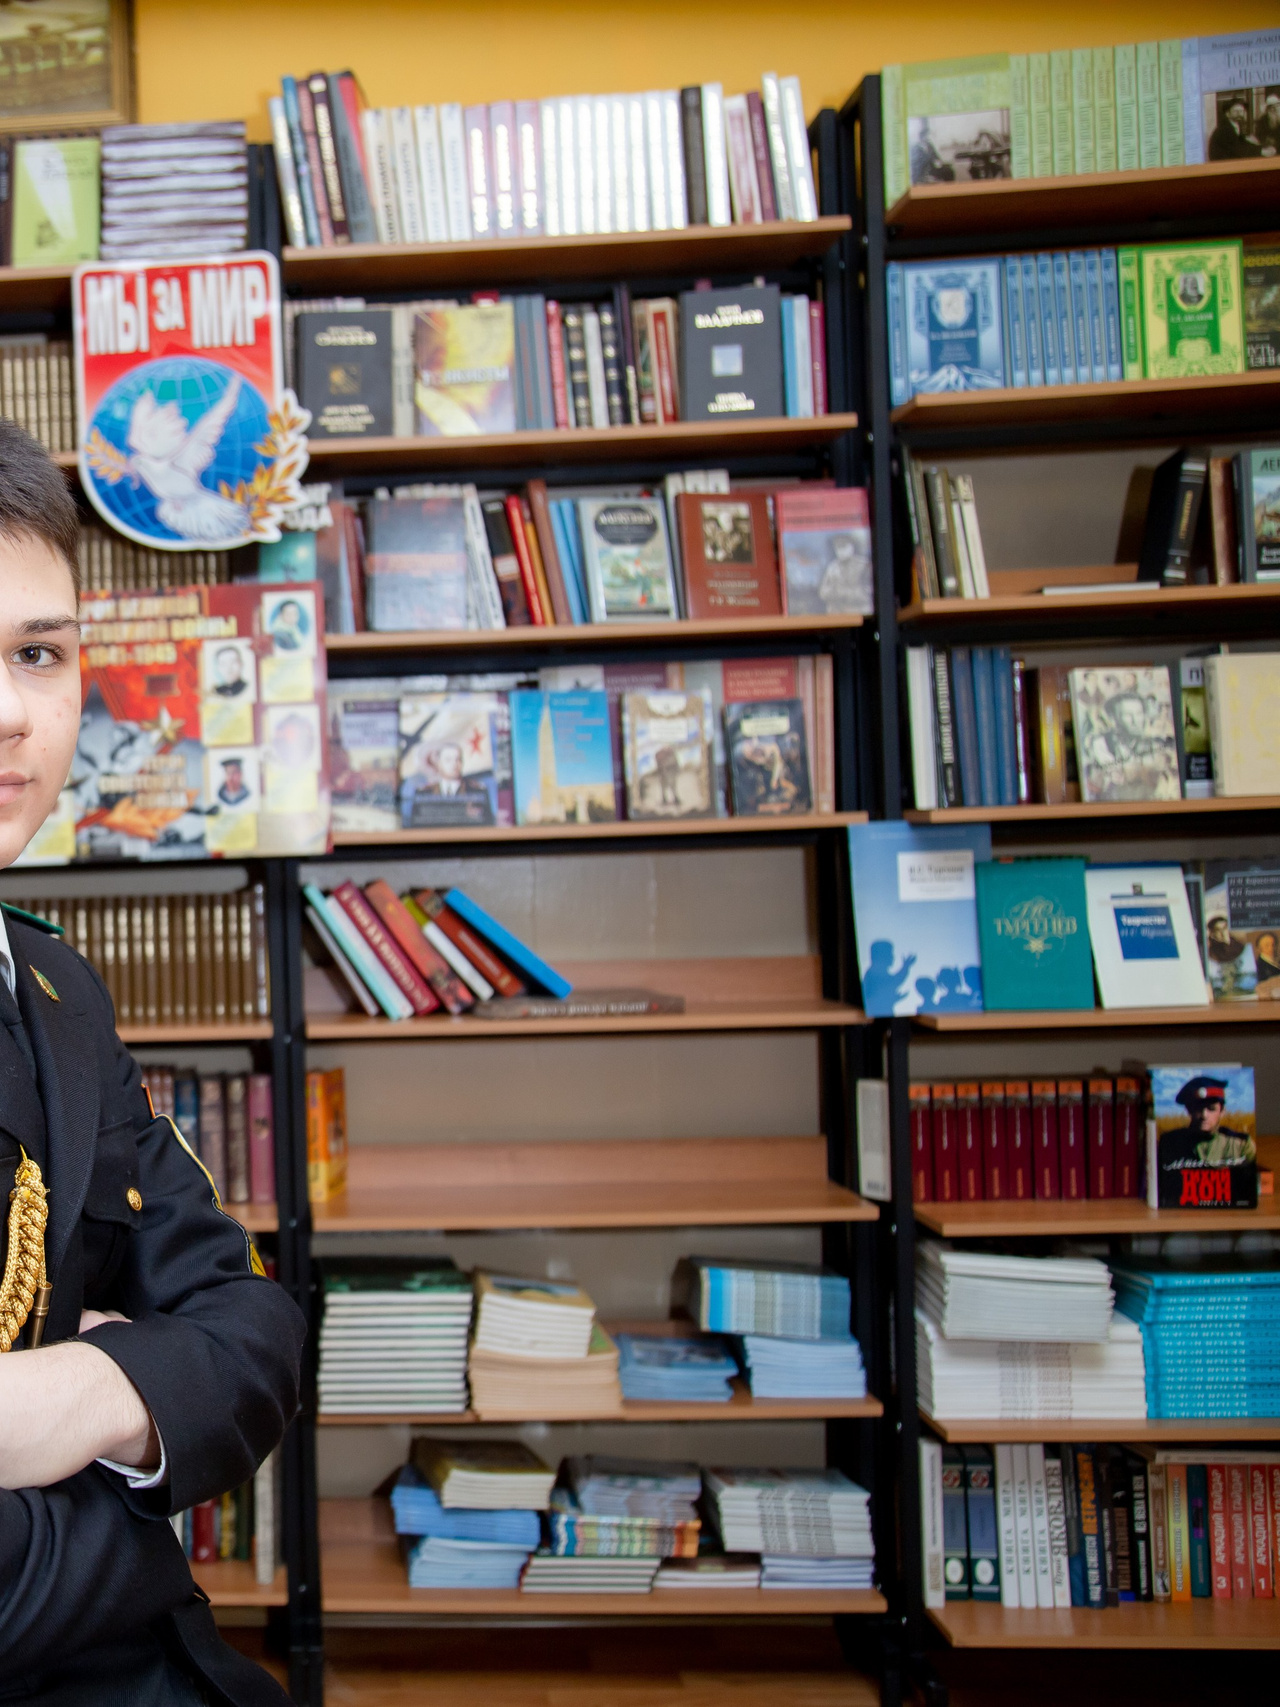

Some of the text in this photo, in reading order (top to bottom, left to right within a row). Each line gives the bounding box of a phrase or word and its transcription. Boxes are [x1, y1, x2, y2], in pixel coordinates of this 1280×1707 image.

[85, 266, 267, 355] МЫ ЗА МИР
[1179, 1178, 1232, 1207] ДОН
[1045, 1465, 1069, 1557] ЯКОВЛЕВ
[1211, 1468, 1226, 1565] АРКАДИЙ ГАЙДАР
[1231, 1468, 1245, 1565] АРКАДИЙ ГАЙДАР
[1252, 1469, 1267, 1566] АРКАДИЙ ГАЙДАР
[1216, 1575, 1227, 1590] 3
[1237, 1576, 1245, 1590] 1
[1258, 1576, 1267, 1590] 1
